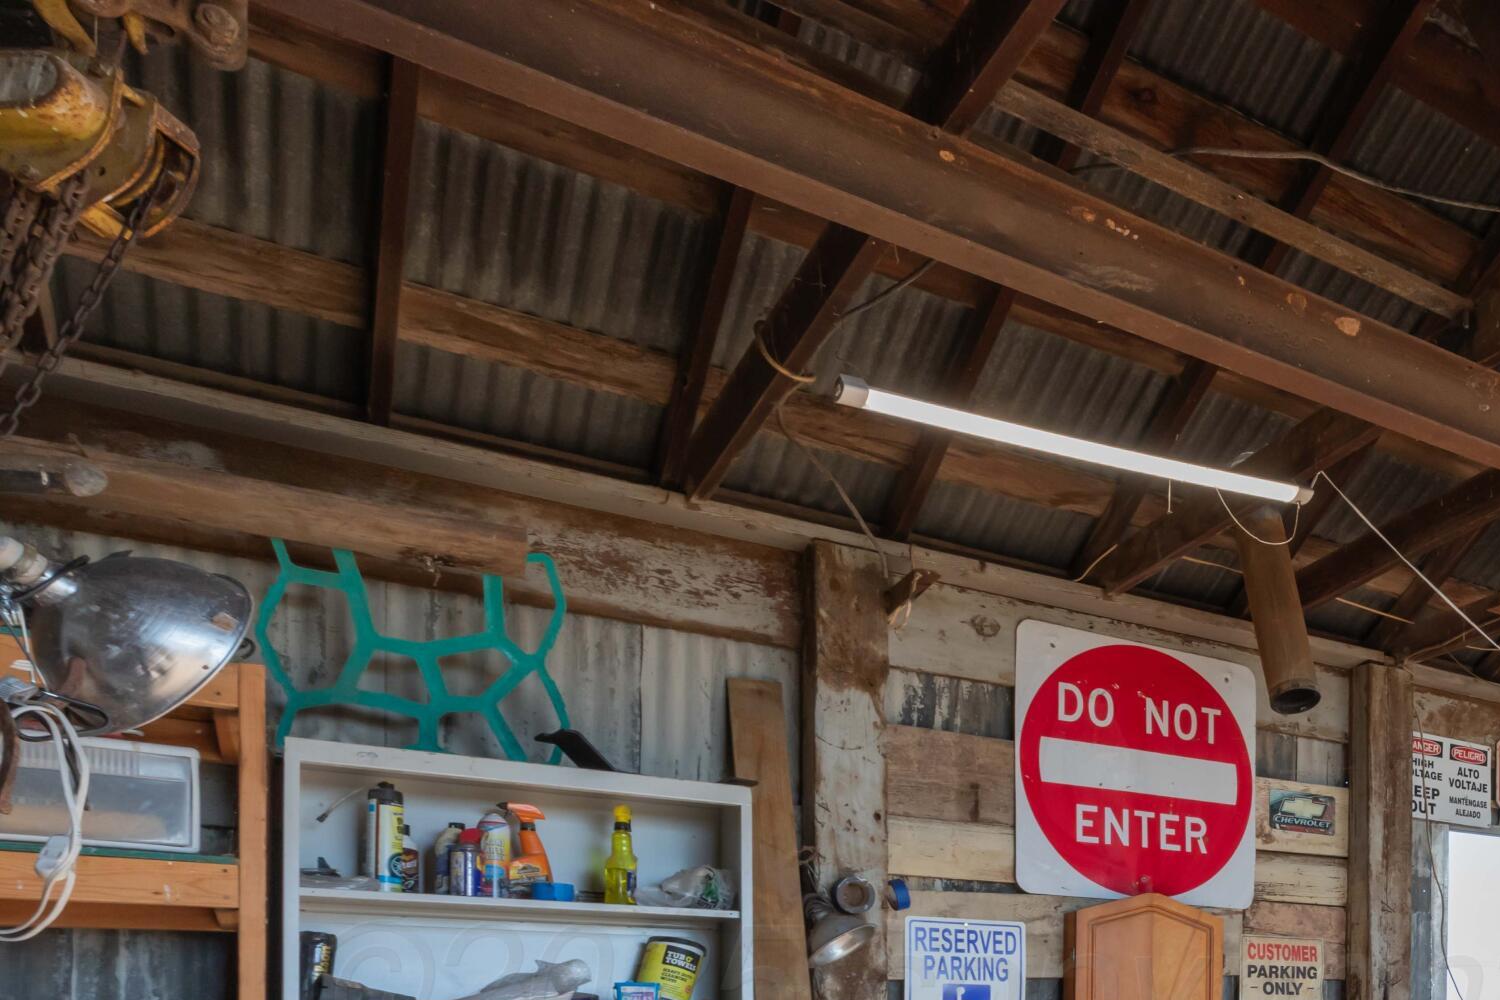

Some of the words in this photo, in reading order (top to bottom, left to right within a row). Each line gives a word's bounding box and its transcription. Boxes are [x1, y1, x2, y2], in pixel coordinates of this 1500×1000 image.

[1058, 681, 1115, 728] DO
[1145, 696, 1222, 744] NOT
[1412, 740, 1440, 753] ANGER
[1453, 748, 1485, 762] PELIGRO
[1412, 768, 1443, 781] LTAGE
[1457, 766, 1480, 779] ALTO
[1414, 784, 1440, 800] EEP
[1448, 777, 1488, 793] VOLTAJE
[1455, 808, 1481, 819] ALEJADO
[1273, 814, 1330, 828] CHEVROLET
[1075, 803, 1209, 855] ENTER
[914, 926, 1017, 955] RESERVED
[666, 950, 686, 960] TUB
[1247, 942, 1318, 962] CUSTOMER
[665, 957, 697, 971] TOWELS
[923, 955, 1009, 982] PARKING
[1247, 964, 1318, 980] PARKING
[1262, 981, 1303, 995] ONLY
